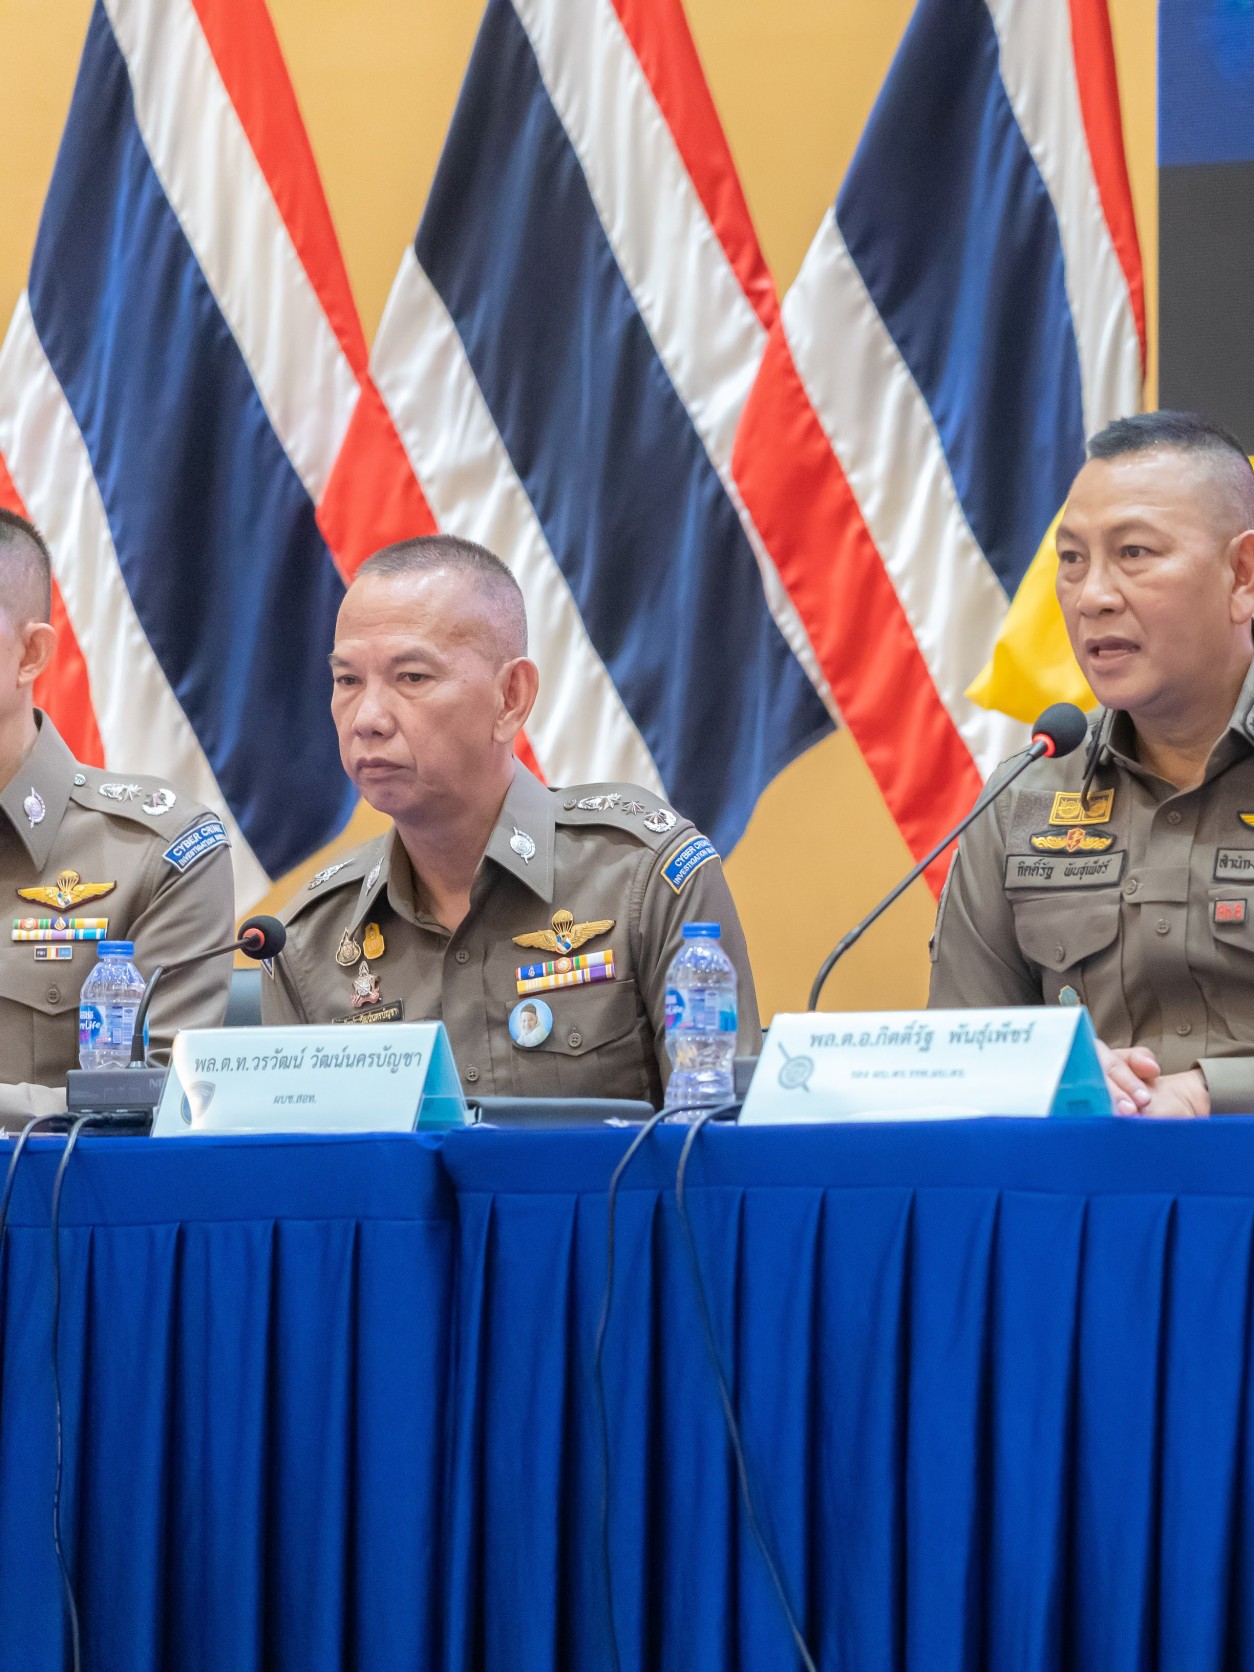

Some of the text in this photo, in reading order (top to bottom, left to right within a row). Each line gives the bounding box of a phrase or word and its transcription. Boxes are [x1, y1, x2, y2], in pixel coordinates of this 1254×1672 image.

[172, 832, 202, 856] CYBER
[674, 845, 697, 867] CYBER
[194, 1045, 422, 1074] พล.ต.ท.วรวัฒน์ วัฒน์นครบัญชา
